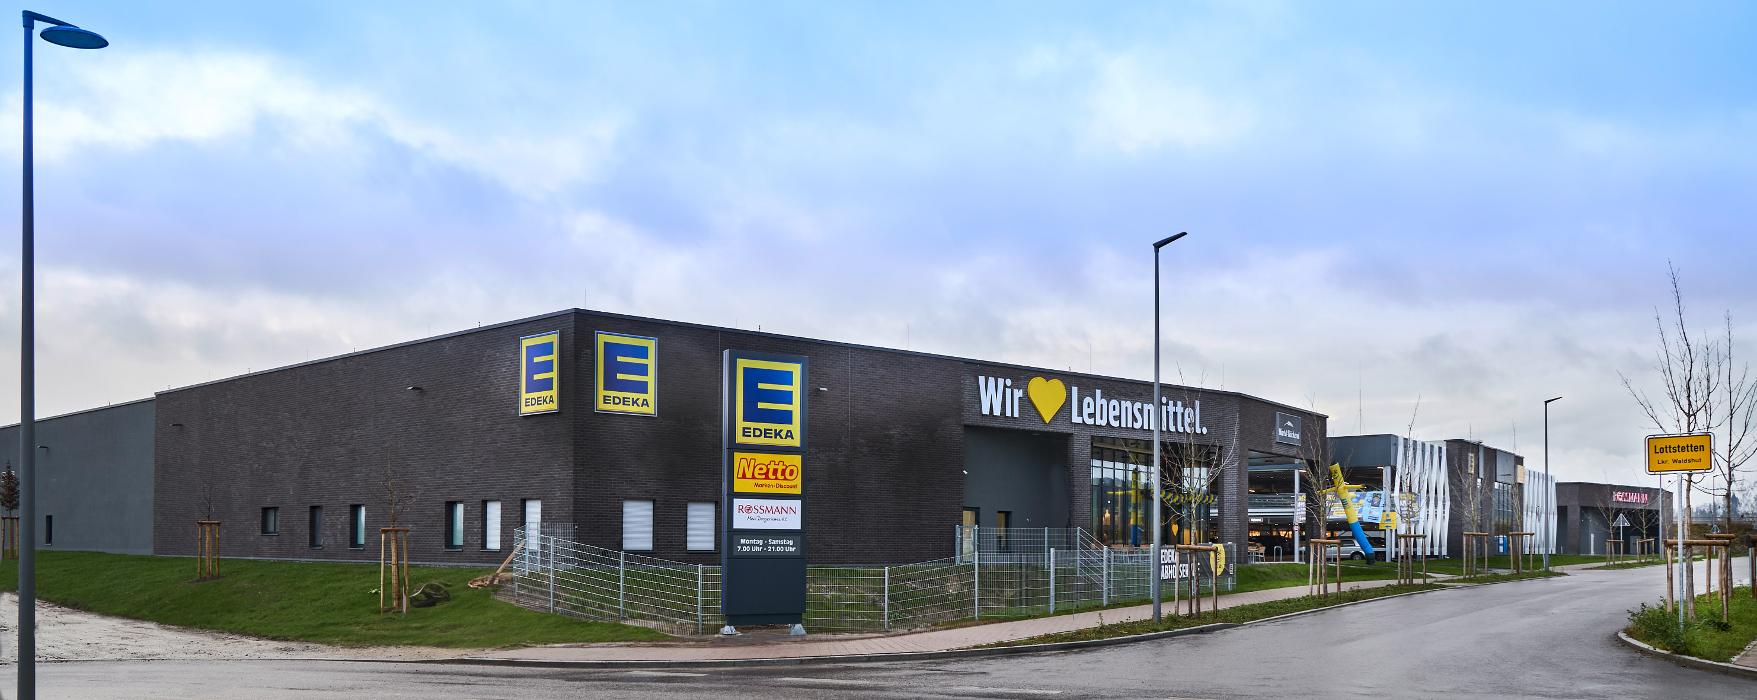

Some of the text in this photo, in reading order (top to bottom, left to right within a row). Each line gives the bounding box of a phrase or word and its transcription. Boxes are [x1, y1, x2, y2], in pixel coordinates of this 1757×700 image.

[524, 394, 555, 407] EDEKA
[602, 394, 650, 408] EDEKA
[978, 375, 1208, 435] Wir Lebensmittel.
[742, 426, 795, 440] EDEKA
[1654, 443, 1705, 454] Lottstetten
[736, 457, 799, 481] Netto
[737, 504, 797, 515] ROSSMANN
[740, 538, 764, 546] Montag
[768, 538, 794, 546] Samstag
[1160, 548, 1178, 564] EDEK
